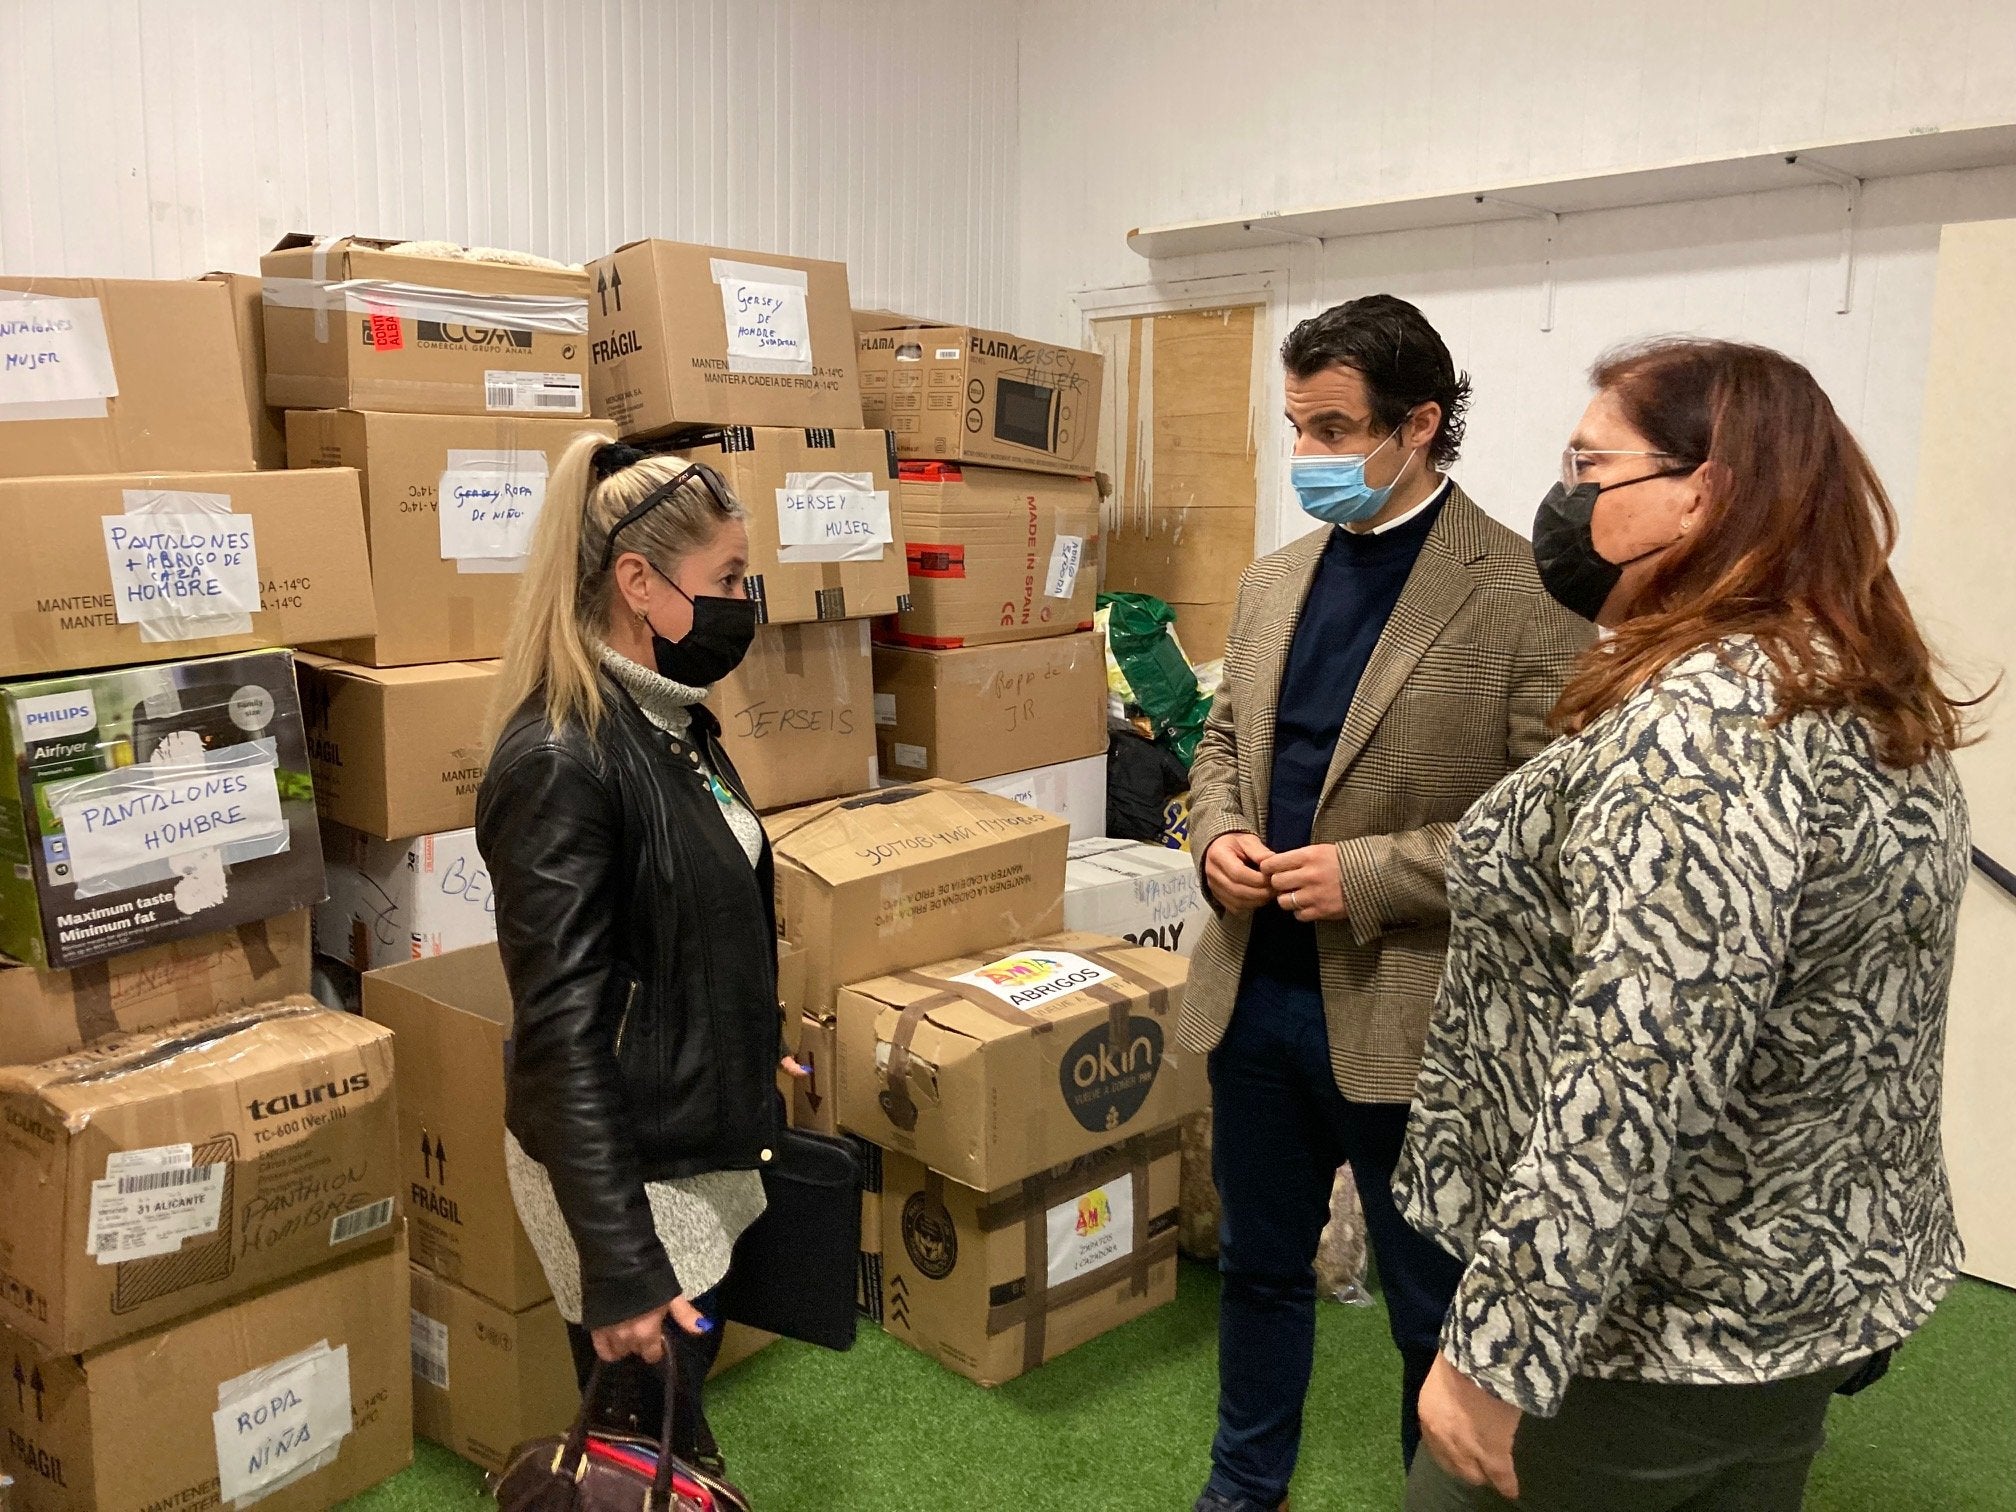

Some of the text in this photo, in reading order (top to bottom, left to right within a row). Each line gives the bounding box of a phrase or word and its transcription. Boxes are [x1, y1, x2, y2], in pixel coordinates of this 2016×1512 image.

[757, 314, 771, 323] DE
[417, 341, 533, 355] COMERCIAL GRUPO ANAYA
[592, 330, 643, 365] FRÁGIL
[861, 337, 895, 350] FLAMA
[971, 336, 1018, 362] FLAMA
[6, 352, 60, 371] MUJER
[692, 358, 728, 370] MANTEN
[704, 373, 740, 385] MANTER
[740, 376, 748, 385] A
[749, 376, 780, 387] CADEIA
[781, 378, 791, 388] DE
[795, 378, 812, 389] FRIO
[505, 484, 532, 496] ROPA
[472, 509, 485, 521] DE
[111, 527, 250, 551] PANTALONES
[826, 520, 875, 537] MUJER
[147, 551, 216, 569] ABRIGO
[224, 553, 241, 566] DE
[1021, 496, 1037, 625] MADE IN SPAIN
[151, 566, 200, 581] CAZA
[128, 579, 222, 602] HOMBRE
[38, 594, 114, 612] MANTENE
[26, 706, 90, 725] PHILIPS
[734, 700, 853, 739] JERSEIS
[34, 741, 87, 760] Airfryer
[441, 768, 483, 782] MANTE
[456, 784, 478, 796] MAN
[81, 775, 248, 833] PANTALONES
[144, 805, 247, 850] HOMBRE
[989, 874, 1031, 894] MANTENER
[56, 892, 174, 928] Maximum taste
[1153, 892, 1199, 922] MUJER
[59, 920, 131, 944] Minimum
[133, 910, 157, 925] fat
[1009, 968, 1100, 1006] ABRIGOS
[1074, 1036, 1152, 1089] okin
[246, 1072, 370, 1121] taurus
[254, 1121, 299, 1144] TC-600
[154, 1194, 206, 1212] ALICANTE
[411, 1182, 464, 1226] FRÁGIL
[236, 1388, 302, 1435] ROPA
[7, 1427, 67, 1489] FRÁGIL
[248, 1422, 311, 1474] NIÑA
